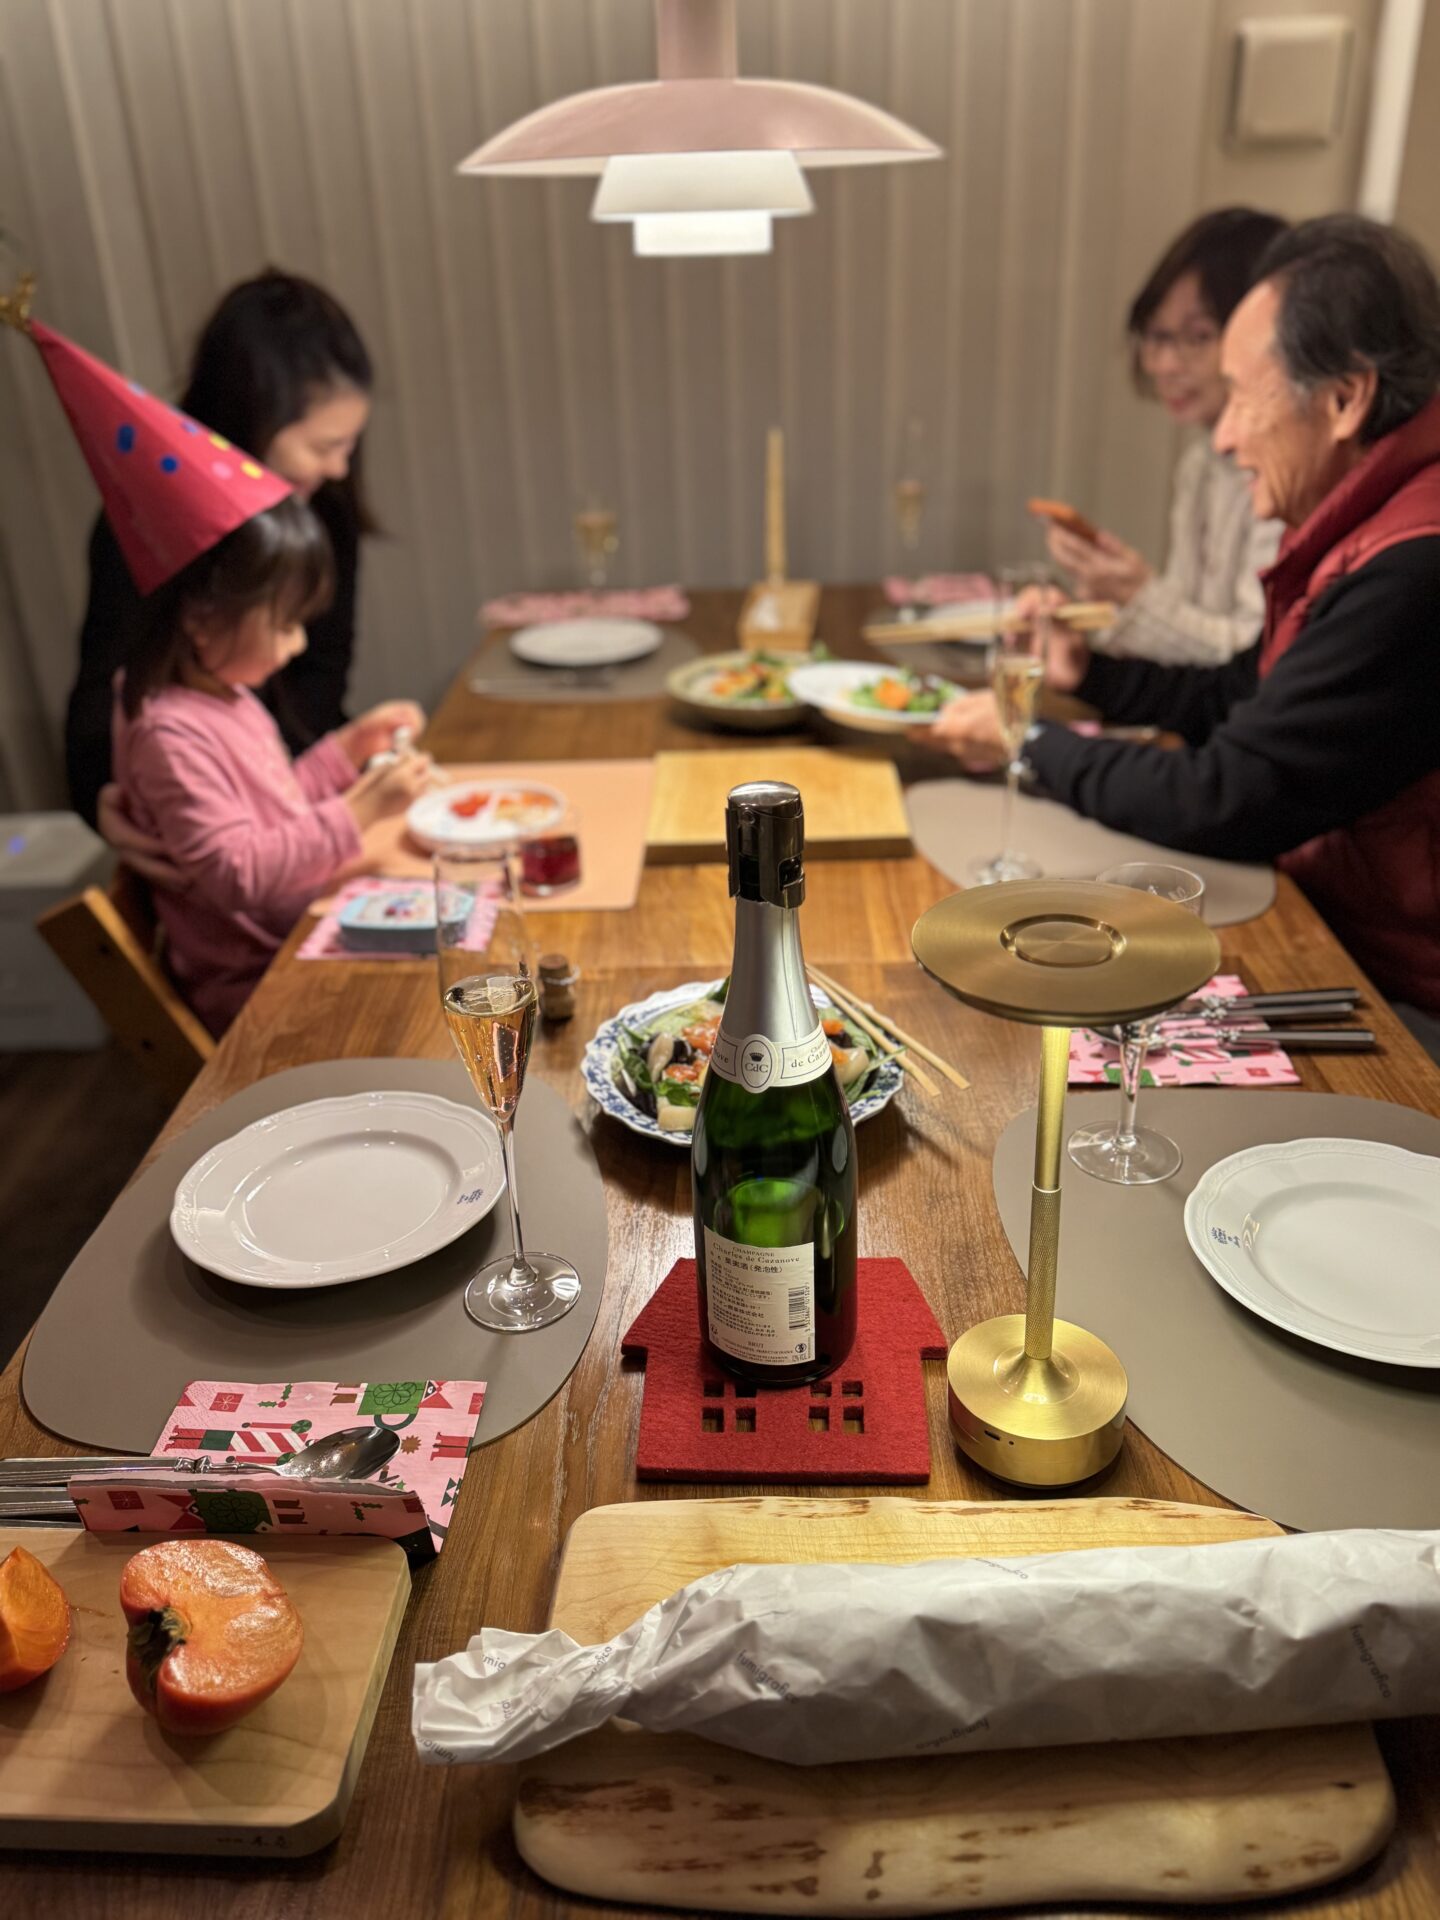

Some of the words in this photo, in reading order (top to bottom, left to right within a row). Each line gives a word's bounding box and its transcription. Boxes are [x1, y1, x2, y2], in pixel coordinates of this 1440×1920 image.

[744, 1063, 769, 1073] CdC
[791, 1059, 804, 1068] de
[712, 1242, 743, 1260] Charles
[757, 1256, 800, 1264] Cazanove
[732, 1247, 775, 1257] CHAMPAGNE
